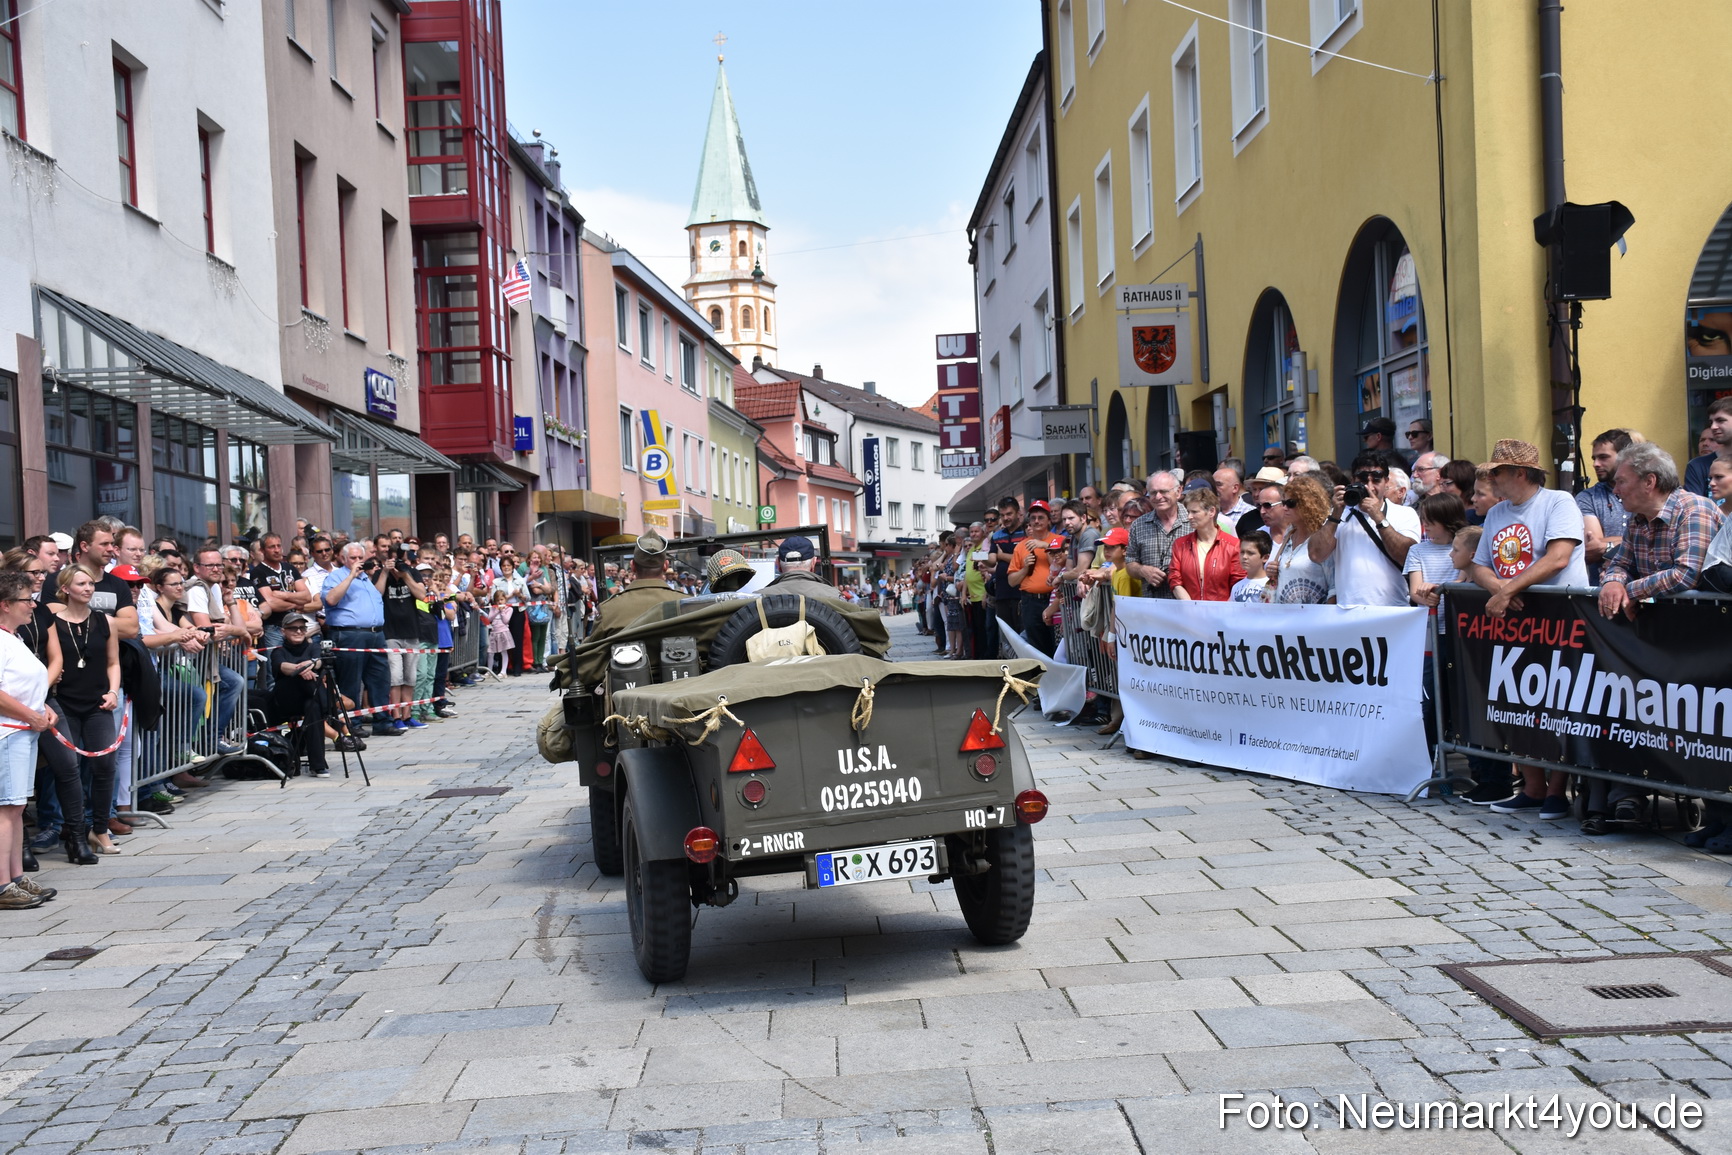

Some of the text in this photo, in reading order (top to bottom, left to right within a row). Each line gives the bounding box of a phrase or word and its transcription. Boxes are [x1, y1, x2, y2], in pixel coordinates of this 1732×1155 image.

[1123, 290, 1181, 303] RATHAUS II
[937, 335, 967, 446] WITT
[1045, 423, 1087, 436] SARAH K
[645, 453, 662, 471] B
[942, 453, 980, 467] WITT
[1493, 525, 1531, 559] IRON CITY
[1498, 560, 1526, 575] 1758
[778, 639, 793, 647] U.S.
[1457, 612, 1586, 649] FAHRSCHULE
[1129, 631, 1388, 687] neumarktaktuell
[1130, 677, 1145, 692] DAS
[1147, 681, 1258, 708] NACHRICHTENPORTAL
[1261, 692, 1286, 710] FÜR
[1290, 697, 1385, 720] NEUMARKT/OPF.
[1488, 645, 1732, 738] Kohlmann
[1138, 718, 1222, 742] www.neumarktaktuell.de
[1249, 734, 1360, 762] facebook.com/neumarktaktuell
[1486, 705, 1535, 728] Neumarkt
[1539, 714, 1601, 739] Burgthann
[1609, 723, 1668, 751] Freystadt
[837, 745, 897, 775] U.S.A.
[820, 776, 922, 812] 0925940
[964, 806, 1006, 828] HQ-7
[740, 831, 805, 856] 2-RNGR
[823, 873, 830, 882] D
[833, 845, 935, 882] R X 693
